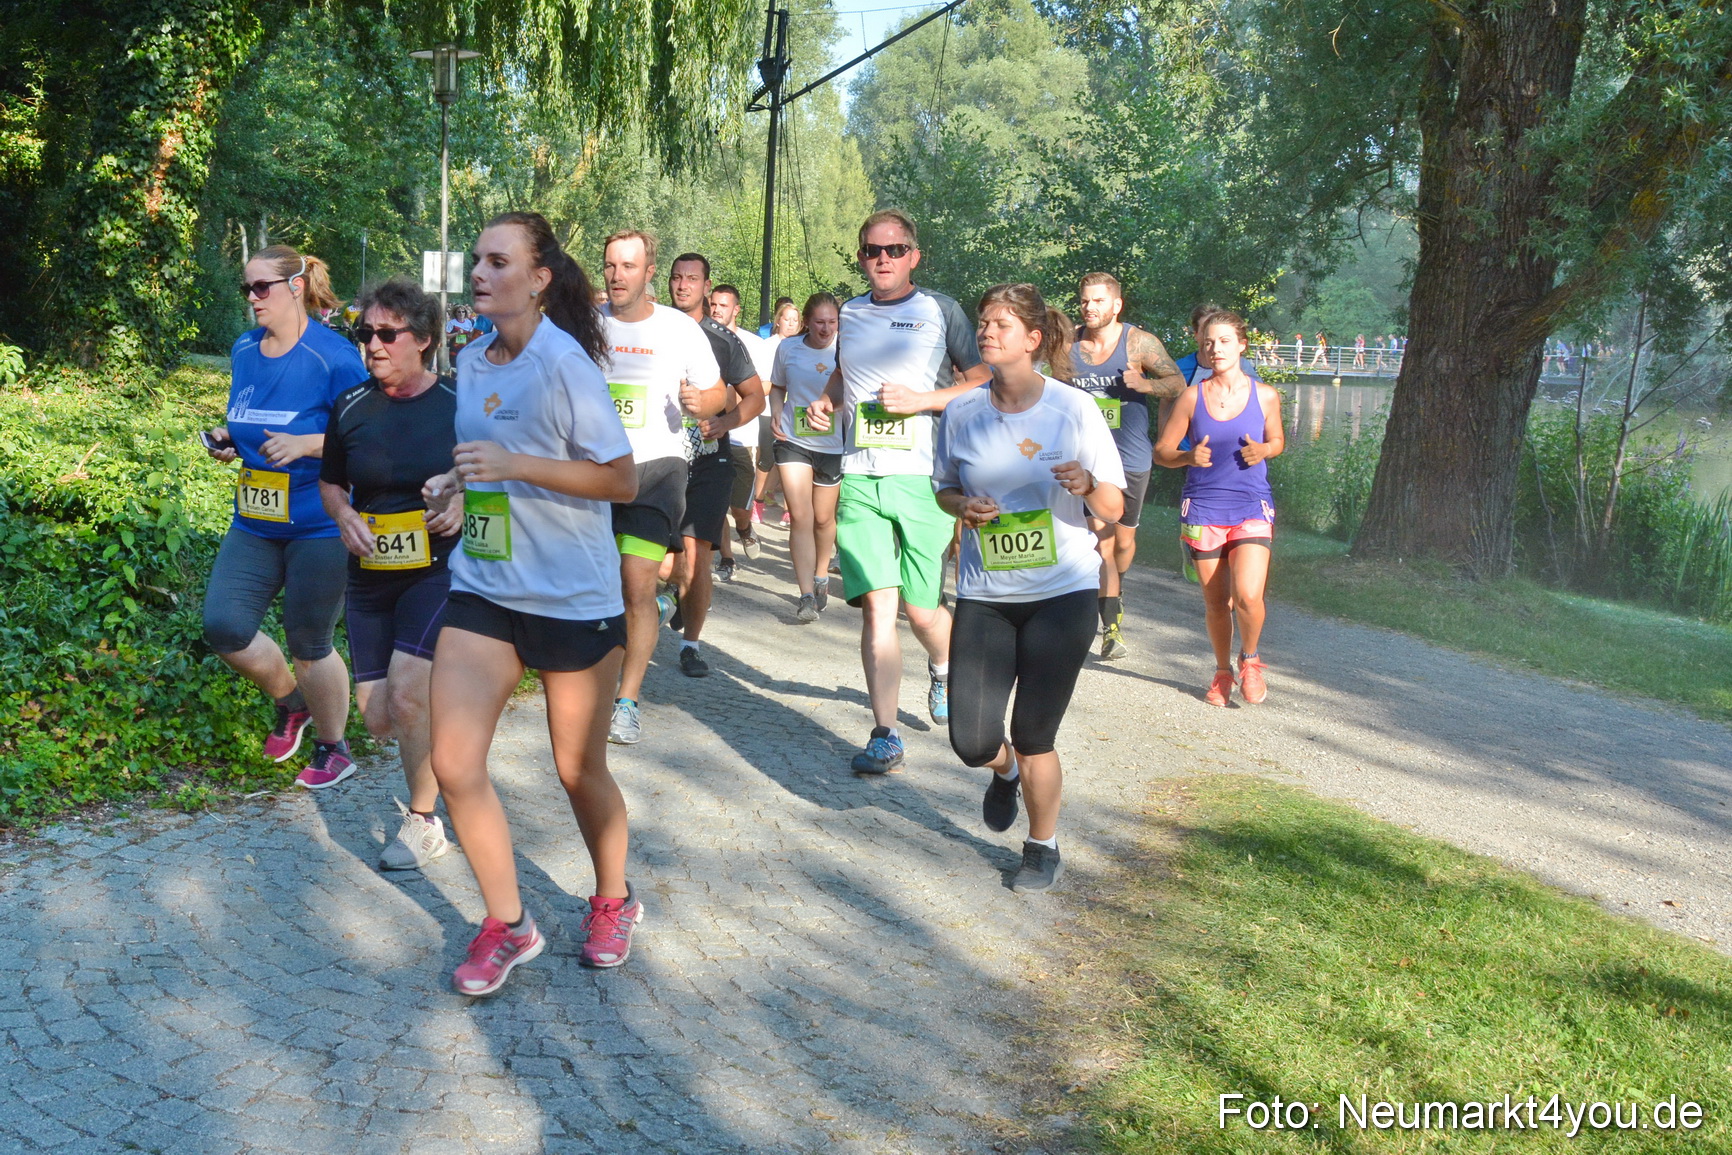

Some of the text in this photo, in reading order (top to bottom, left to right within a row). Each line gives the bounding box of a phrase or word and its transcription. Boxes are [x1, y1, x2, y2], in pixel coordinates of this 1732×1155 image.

[615, 346, 656, 355] KLEBL
[1072, 375, 1118, 388] DENIM
[864, 418, 905, 435] 1921
[243, 486, 278, 508] 1781
[377, 532, 416, 554] 641
[989, 531, 1045, 554] 1002
